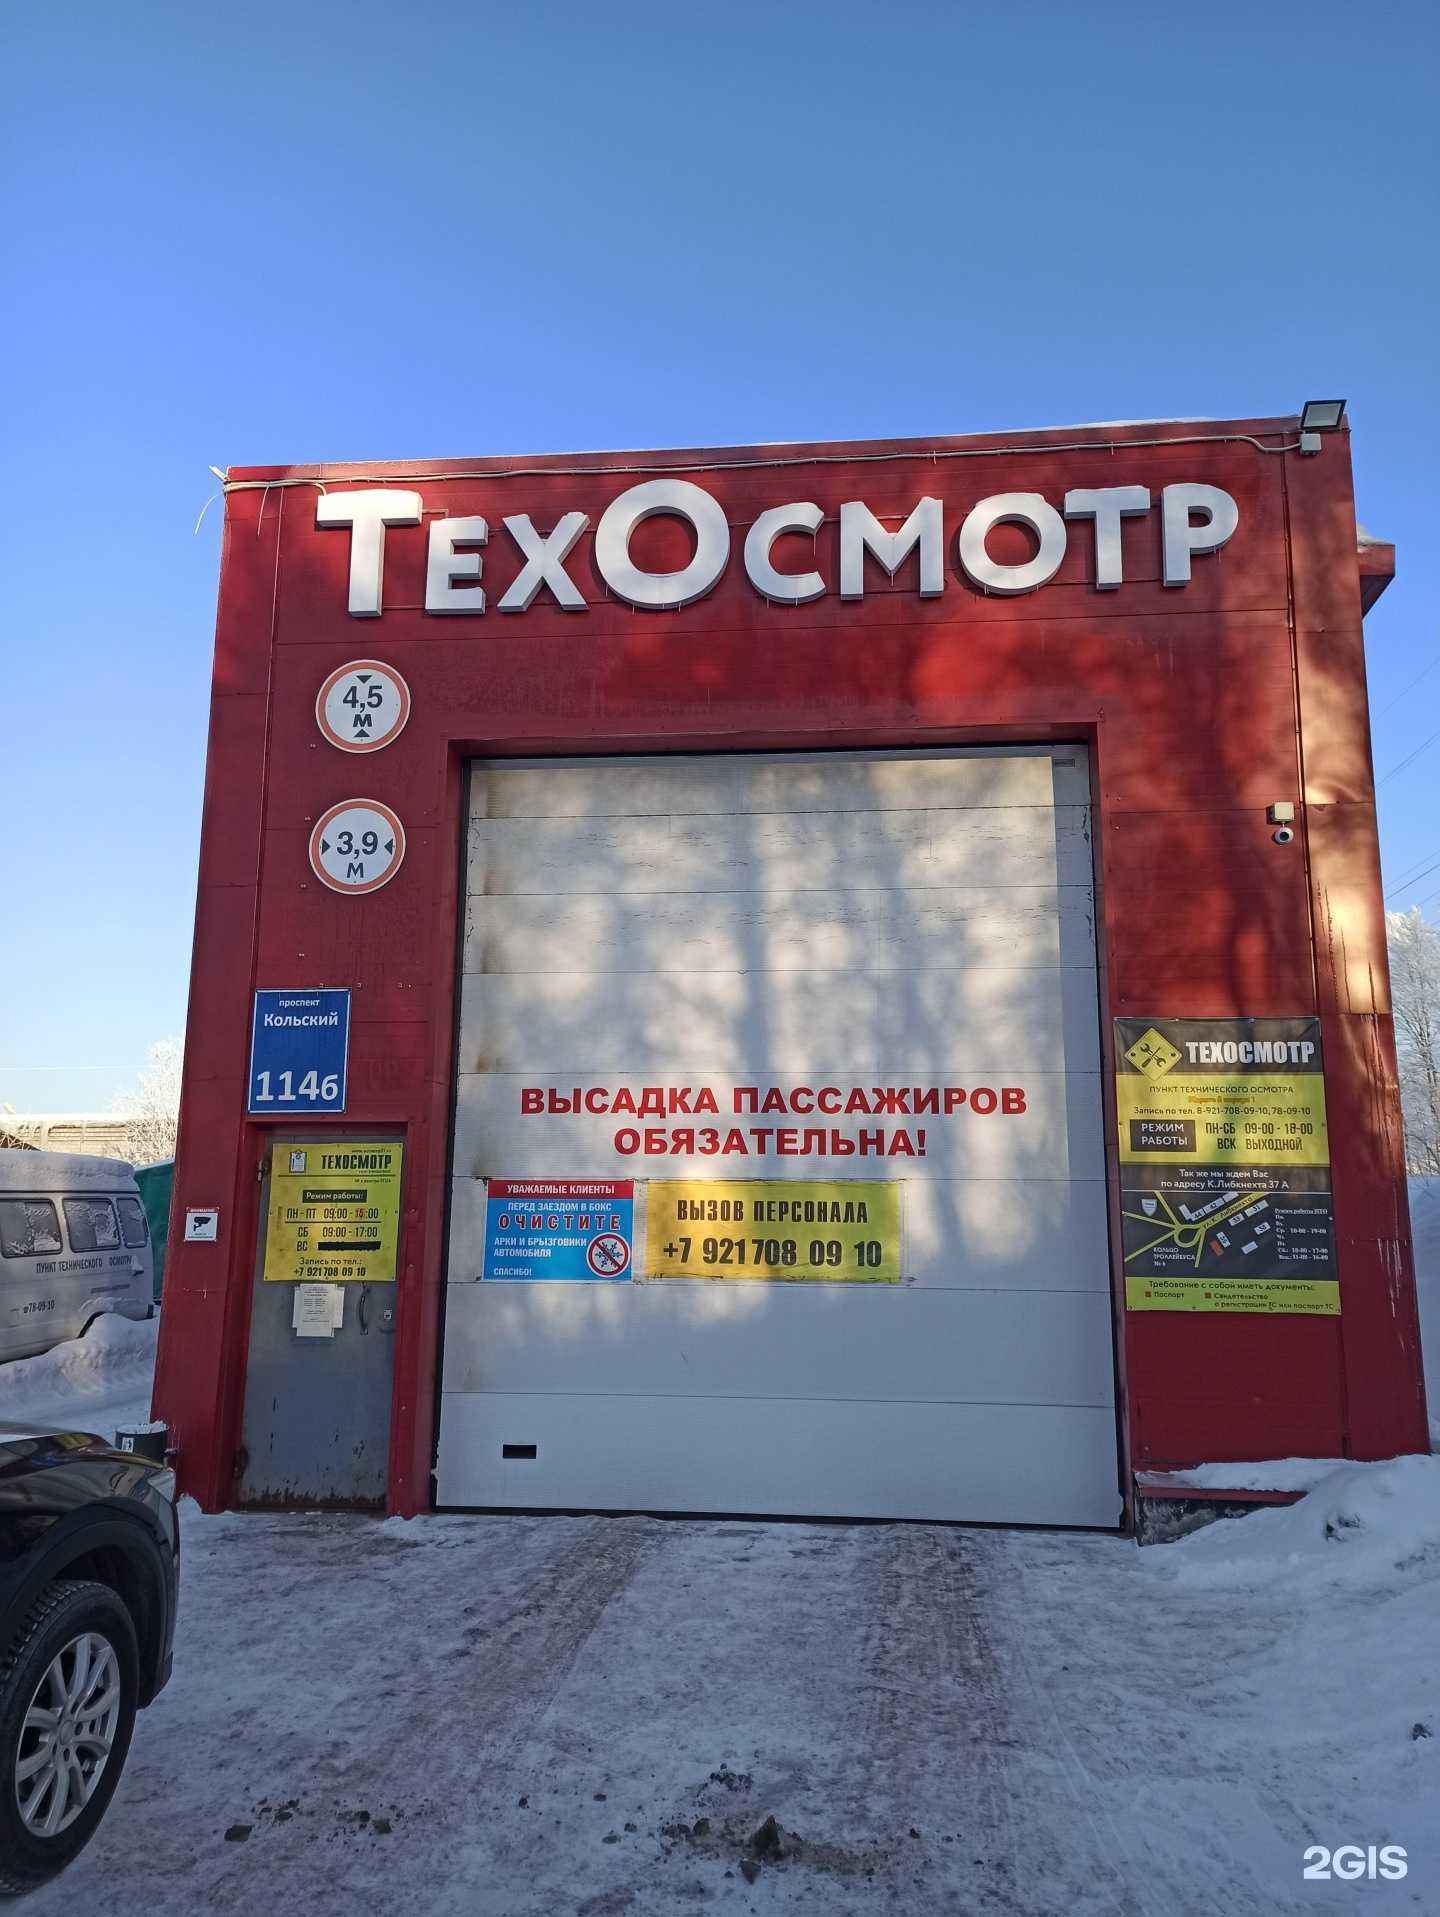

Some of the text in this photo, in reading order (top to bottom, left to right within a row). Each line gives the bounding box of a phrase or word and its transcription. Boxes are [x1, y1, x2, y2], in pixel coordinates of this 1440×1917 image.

[342, 684, 383, 713] 4,5
[336, 830, 379, 860] 3,9
[279, 999, 320, 1009] проспект
[264, 1011, 338, 1027] Кольский
[1186, 1041, 1315, 1065] ТЕХОСМОТР
[520, 1086, 1028, 1119] ВЫСАДКА ПАССАЖИРОВ
[1134, 1106, 1164, 1115] Запись
[1141, 1123, 1185, 1133] РЕЖИМ
[1205, 1122, 1236, 1135] ПН-СБ
[1244, 1122, 1274, 1135] 09-00
[613, 1127, 928, 1157] ОБЯЗАТЕЛЬНА!
[1141, 1136, 1189, 1146] РАБОТЫ
[1217, 1136, 1303, 1151] ВСК ВЫХОДНОЙ
[321, 1154, 393, 1170] ТЕХОСМОТР
[1179, 1168, 1195, 1178] Так
[1196, 1170, 1209, 1178] же
[1210, 1170, 1224, 1178] мы
[1252, 1169, 1269, 1178] Вас
[506, 1184, 615, 1194] УВАЖАЕМЫЕ КЛИЕНТЫ
[1174, 1181, 1206, 1190] адресу
[1268, 1180, 1280, 1189] 37
[1281, 1181, 1290, 1189] А
[306, 1191, 332, 1200] Режим
[287, 1207, 299, 1219] ПН
[305, 1207, 317, 1219] ПТ
[323, 1208, 348, 1219] 09:00
[508, 1202, 612, 1212] ПЕРЕД ЗАЕЗДОМ В БОКС
[676, 1199, 869, 1224] ВЫЗОВ ПЕРСОНАЛА
[498, 1213, 621, 1230] ОЧИСТИТЕ
[297, 1226, 309, 1238] СБ
[322, 1227, 347, 1238] 09:00
[355, 1227, 378, 1238] 17:00
[296, 1240, 308, 1252] ВС
[494, 1237, 588, 1246] АРКИ И БРЫЗГОВИКИ
[493, 1248, 552, 1257] АВТОМОБИЛЯ
[663, 1237, 882, 1267] +7 921 708 09 10
[36, 1262, 57, 1274] ПУНКТ
[58, 1257, 103, 1273] ТЕХНИЧЕСКОГО
[299, 1257, 329, 1265] Запись
[294, 1267, 366, 1277] +7 921 708 09 10
[493, 1267, 532, 1276] СПАСИБО!
